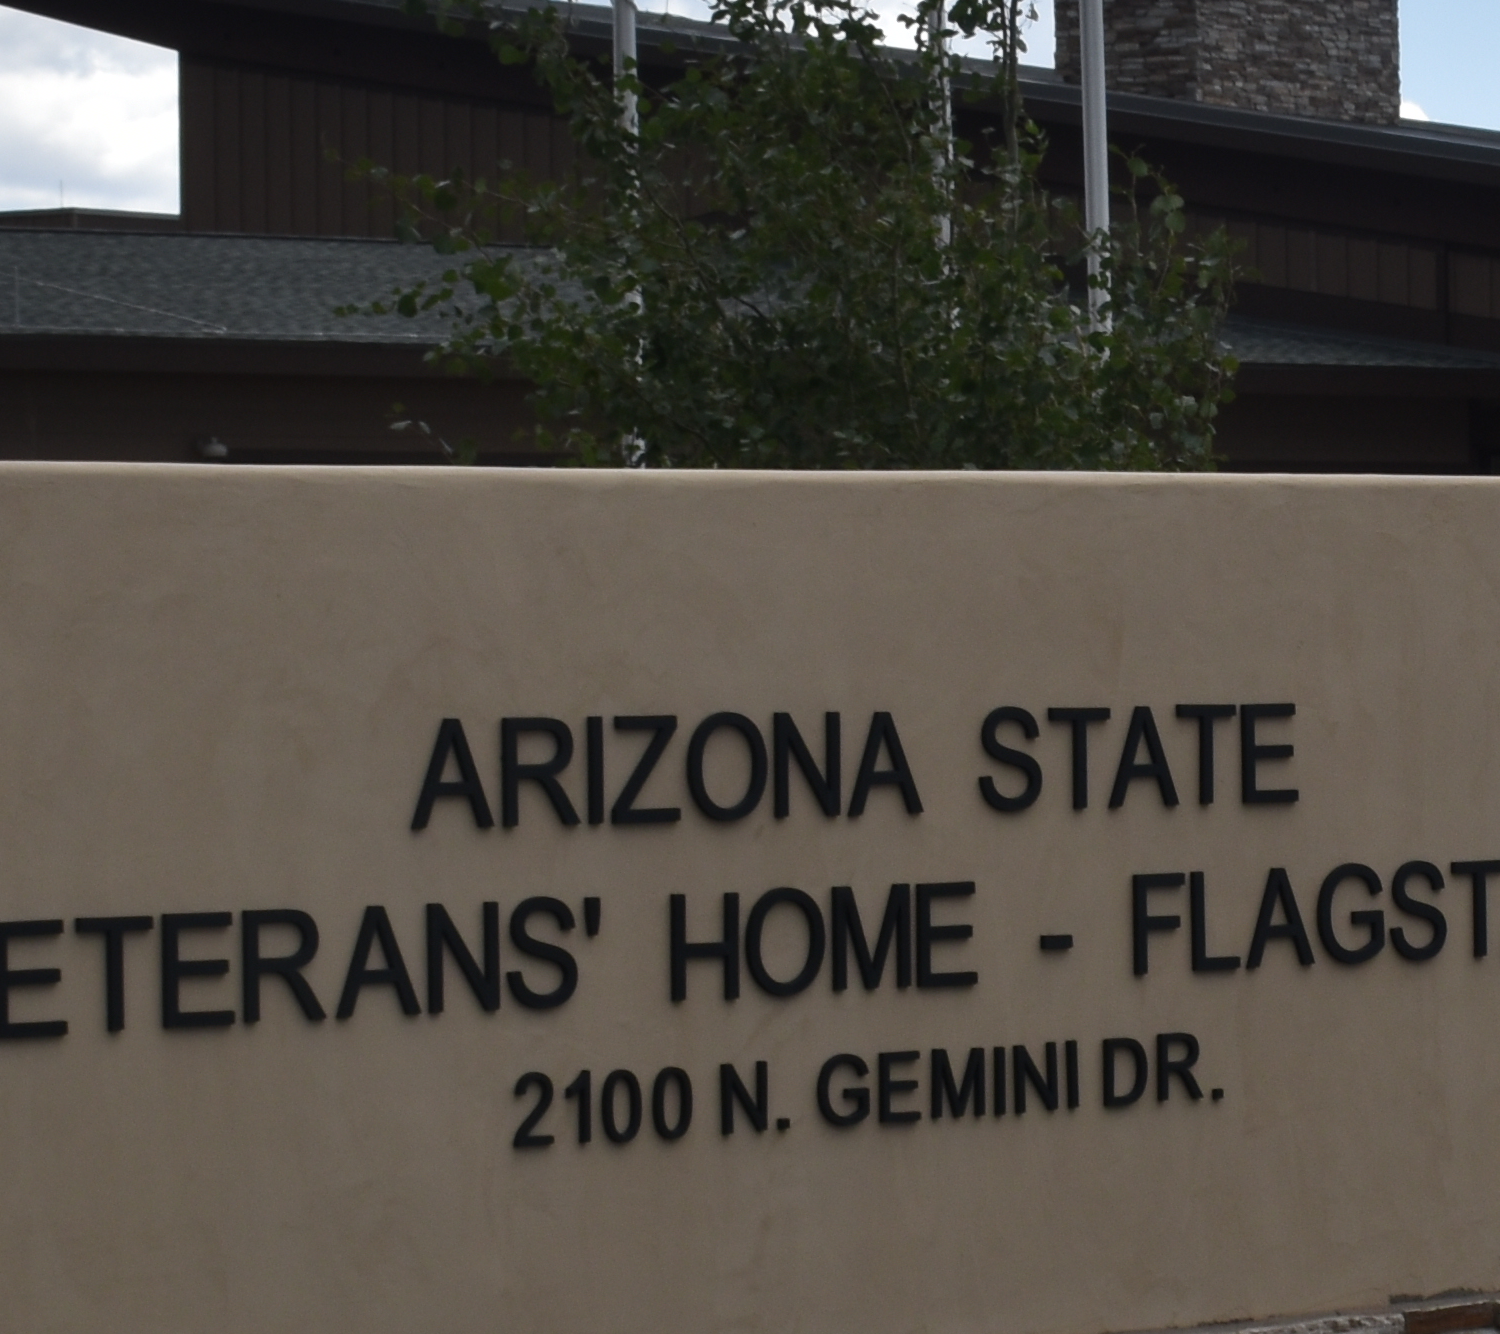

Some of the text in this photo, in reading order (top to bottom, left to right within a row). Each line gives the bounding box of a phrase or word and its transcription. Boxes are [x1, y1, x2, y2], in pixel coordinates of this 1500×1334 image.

[409, 702, 1300, 835] ARIZONA STATE
[668, 880, 979, 1008] HOME
[511, 1031, 1225, 1154] 2100 N. GEMINI DR.
